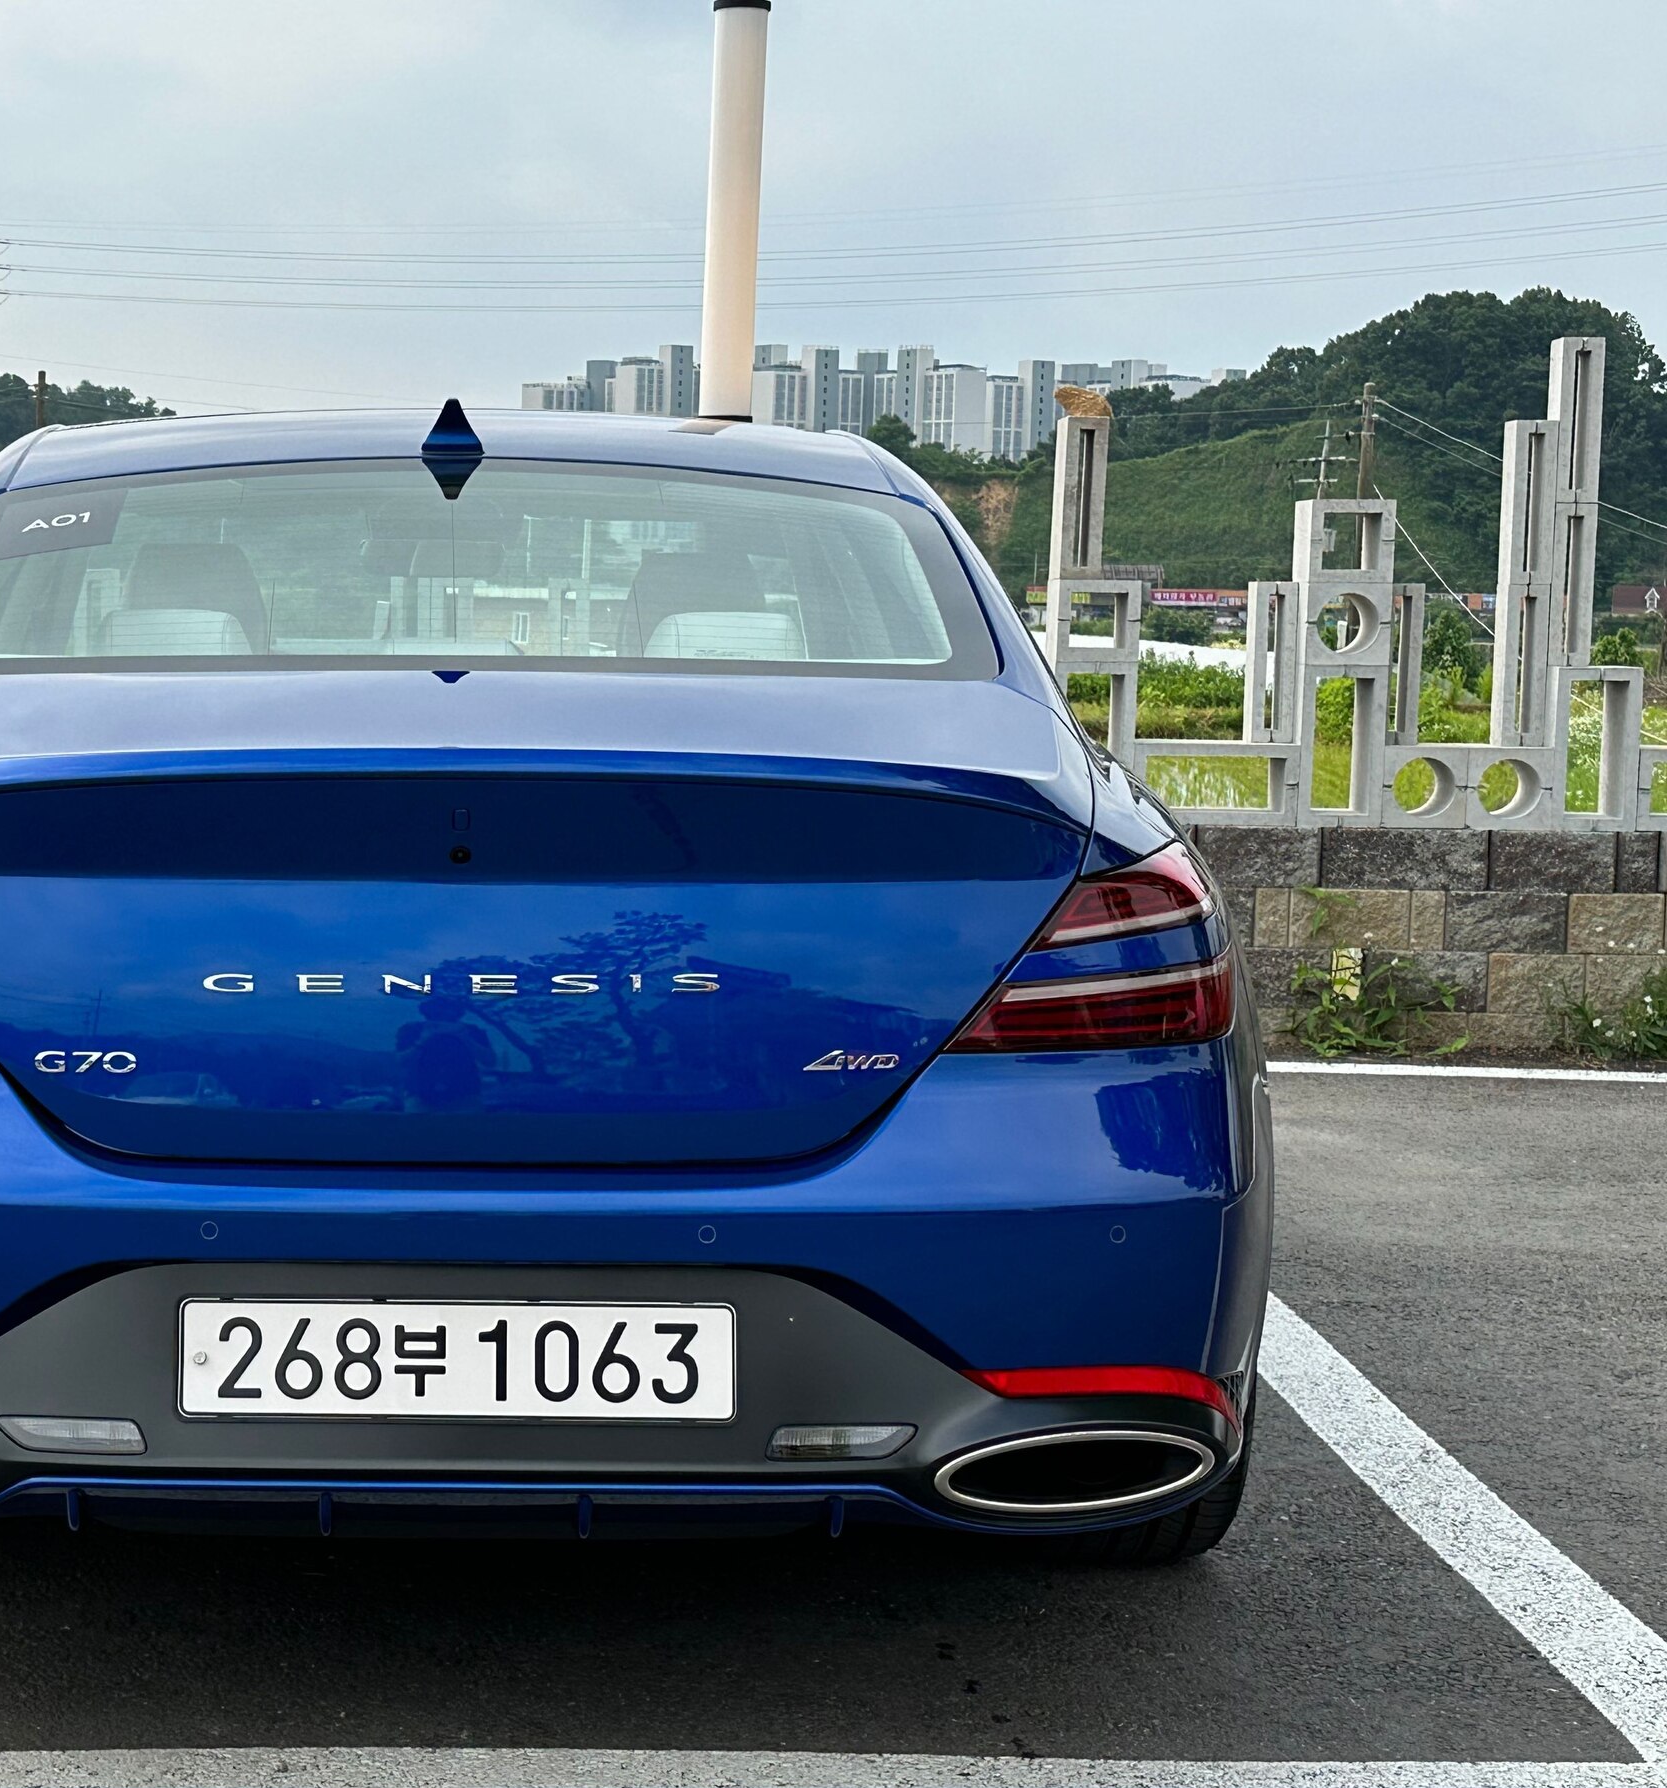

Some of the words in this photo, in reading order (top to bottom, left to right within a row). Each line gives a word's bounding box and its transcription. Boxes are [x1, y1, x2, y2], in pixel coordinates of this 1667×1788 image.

[21, 511, 91, 533] A01
[202, 973, 720, 994] GENESIS
[34, 1050, 137, 1073] G70
[217, 1316, 447, 1400] 268부
[478, 1319, 699, 1404] 1063
